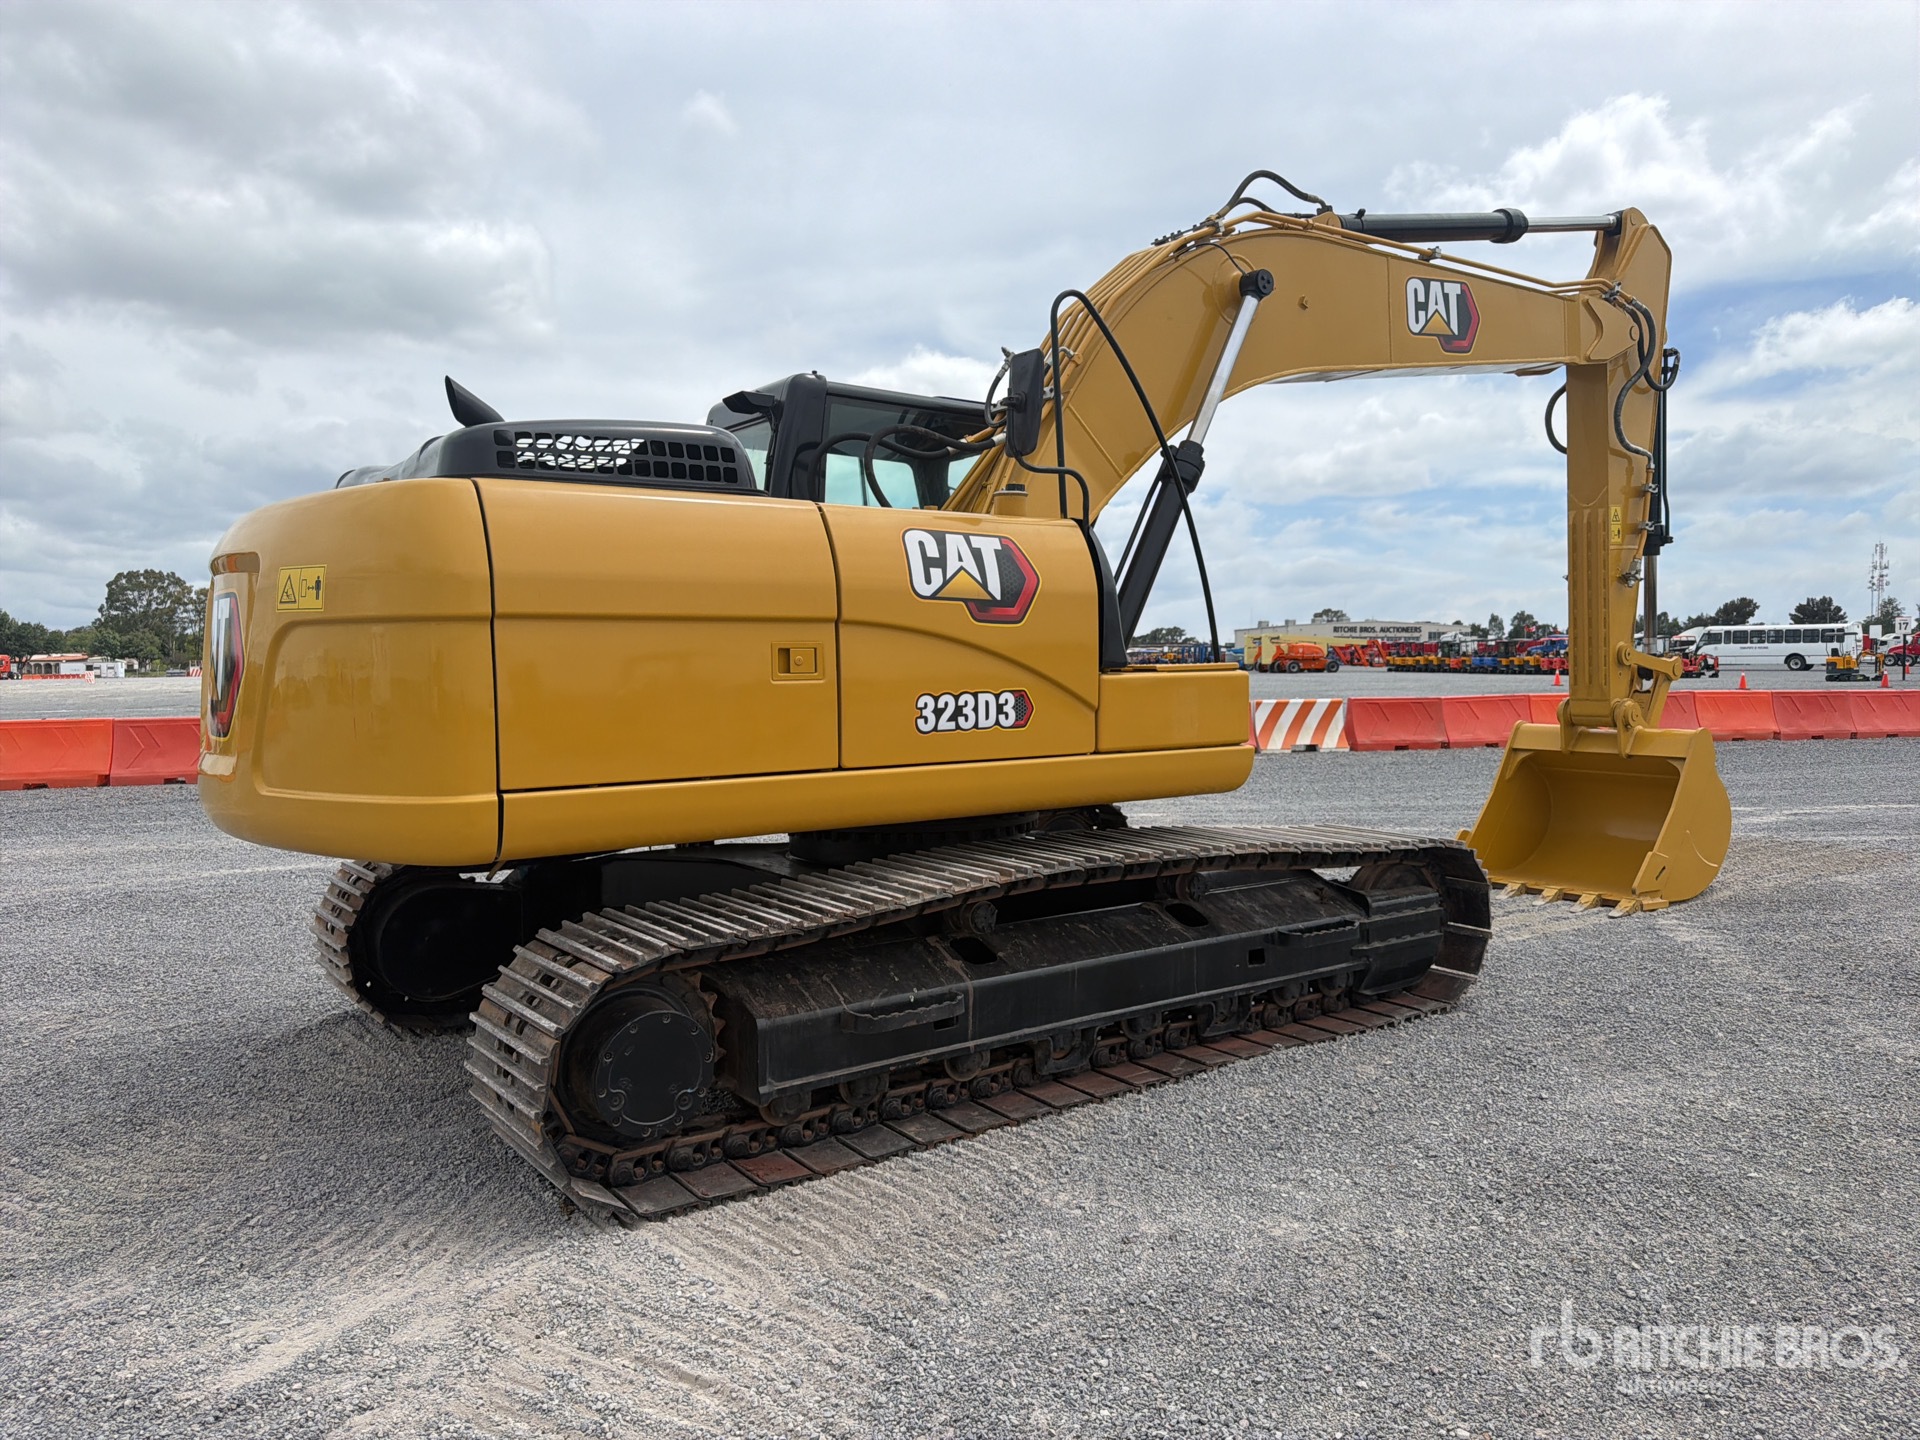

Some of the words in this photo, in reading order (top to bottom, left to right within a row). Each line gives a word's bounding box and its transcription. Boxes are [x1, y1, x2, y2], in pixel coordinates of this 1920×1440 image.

[1406, 278, 1462, 336] CAT
[904, 529, 1002, 601] CAT
[1898, 622, 1909, 631] 17
[916, 691, 1017, 733] 323D3
